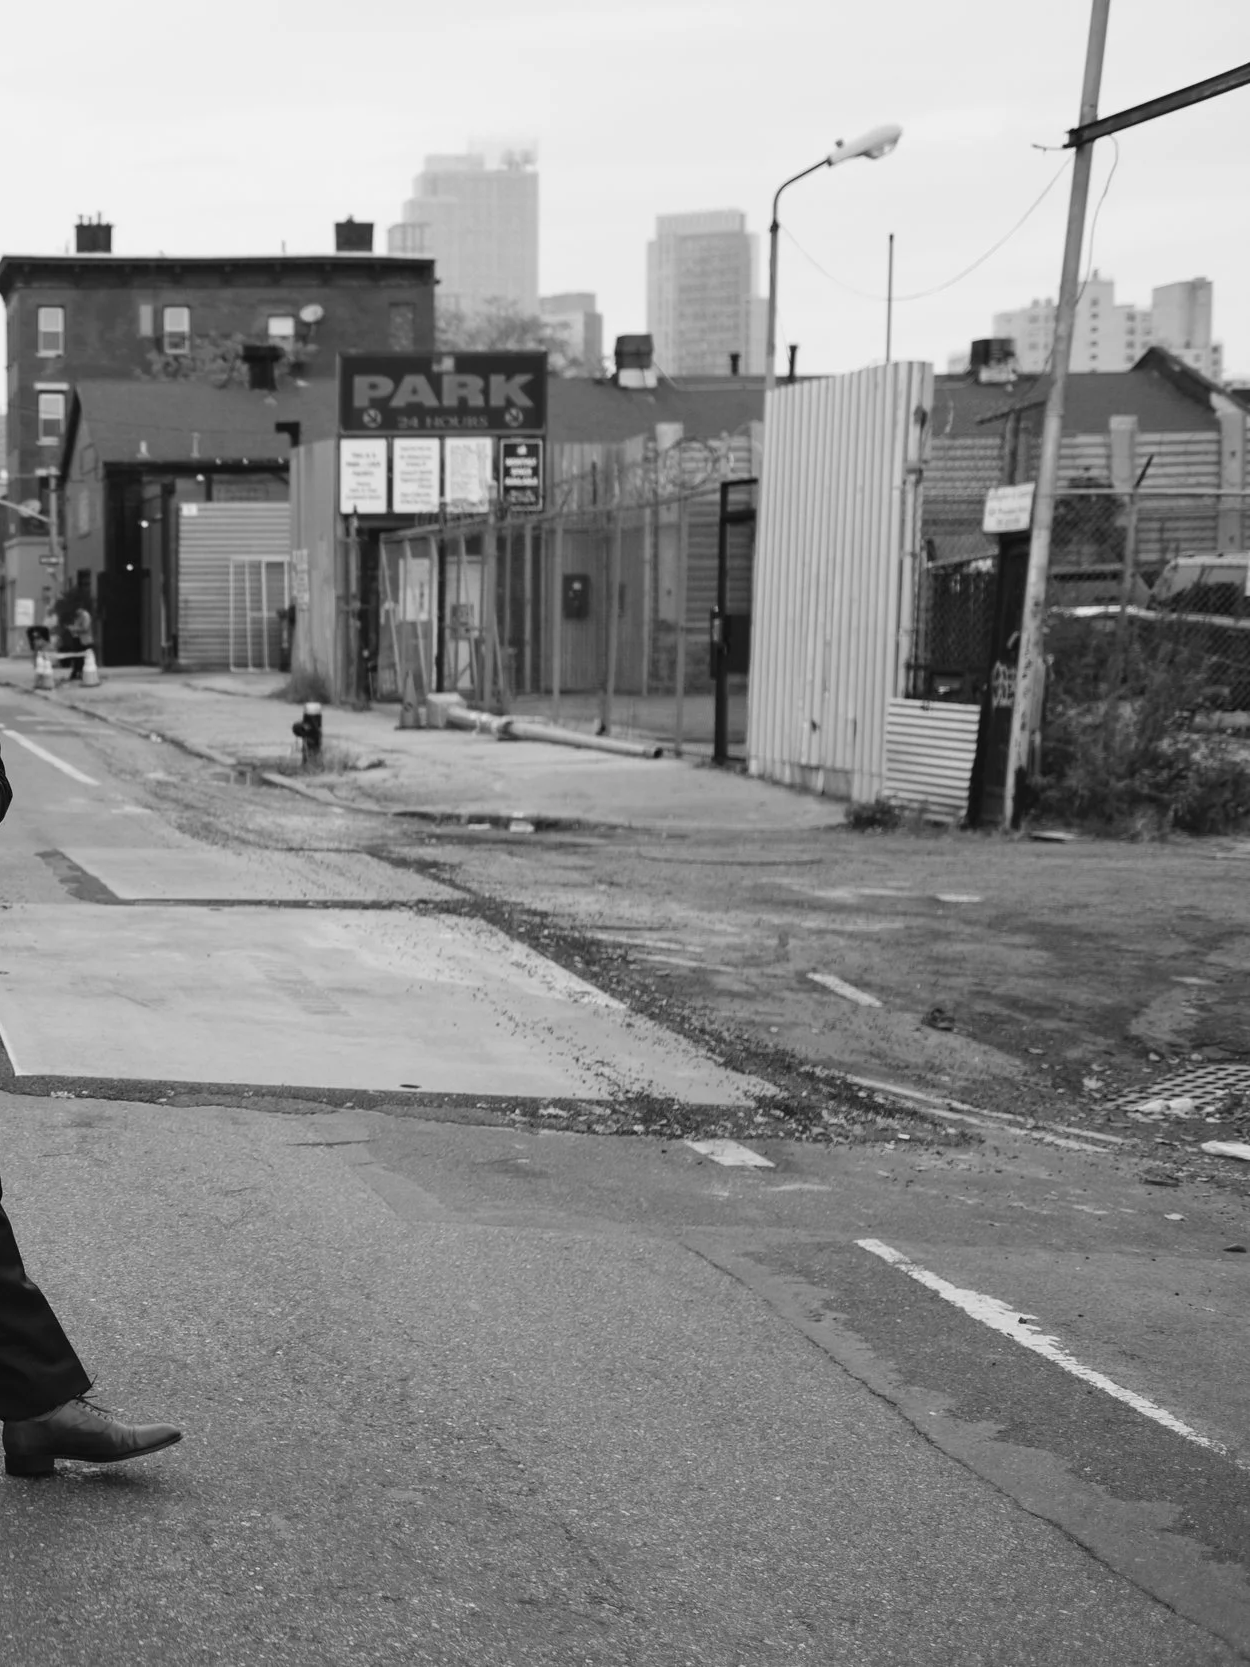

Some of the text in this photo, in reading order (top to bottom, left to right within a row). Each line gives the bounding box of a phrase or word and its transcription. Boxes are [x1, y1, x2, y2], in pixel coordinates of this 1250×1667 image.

[353, 373, 535, 408] PARK
[397, 415, 489, 429] 24 HOURS
